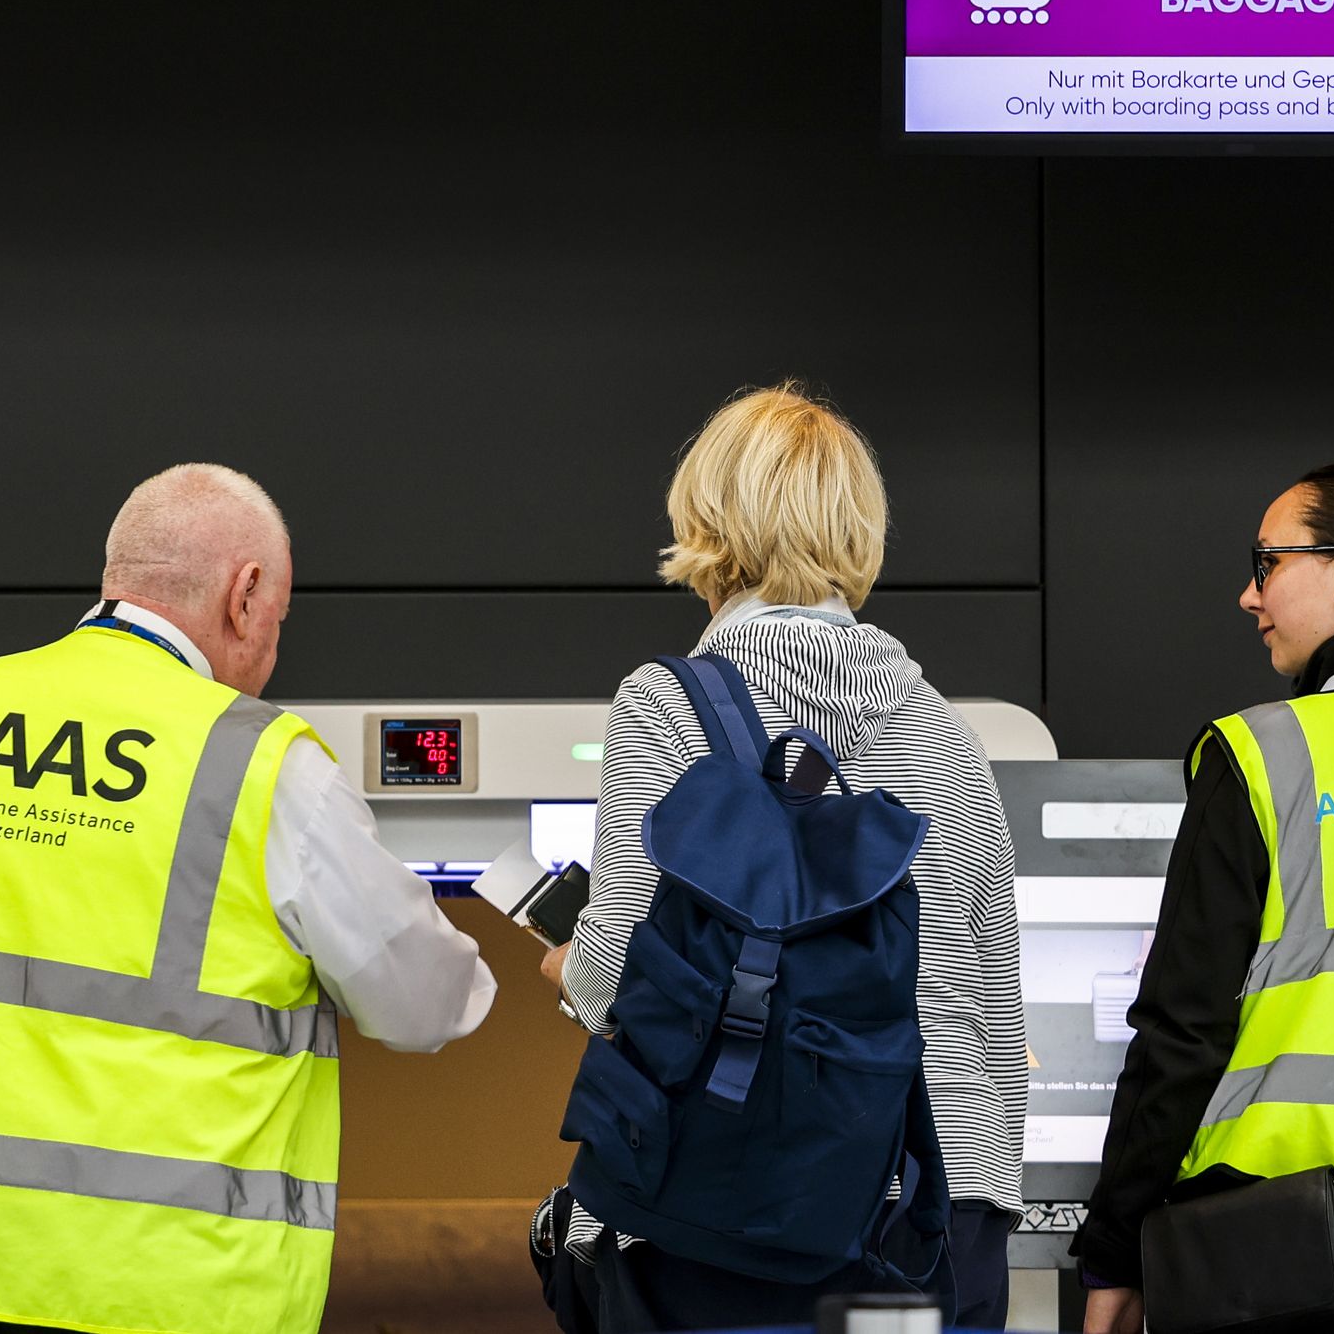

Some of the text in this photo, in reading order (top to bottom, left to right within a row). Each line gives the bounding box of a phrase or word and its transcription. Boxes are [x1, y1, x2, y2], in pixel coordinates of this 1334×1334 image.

[1048, 71, 1085, 89] Nur
[1091, 70, 1125, 89] mit
[1132, 70, 1238, 89] Bordkarte
[1245, 71, 1285, 89] und
[1005, 97, 1055, 120] Only
[1061, 96, 1105, 115] with
[1113, 97, 1211, 120] boarding
[1219, 102, 1270, 120] pass
[1277, 98, 1319, 116] and
[24, 803, 136, 834] Assistance
[1047, 1081, 1074, 1090] stellen
[1075, 1081, 1088, 1090] Sie
[1090, 1081, 1105, 1090] das
